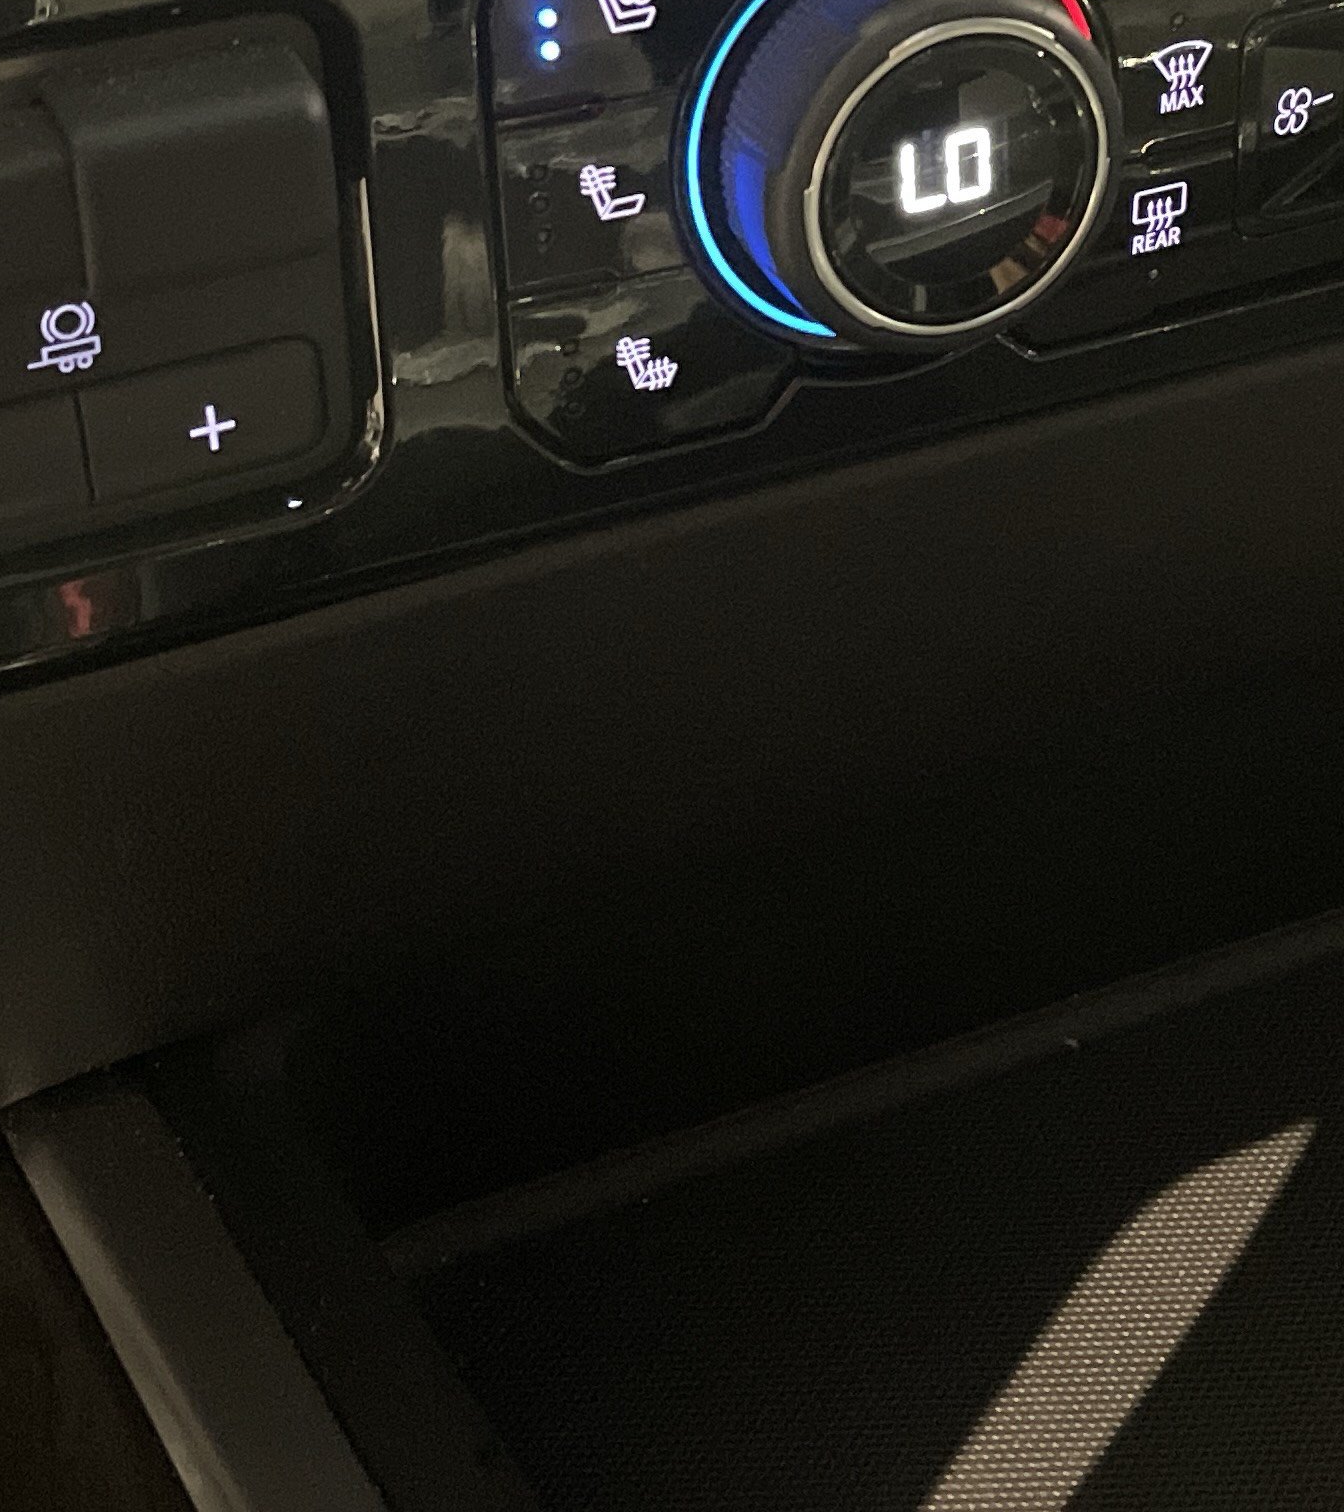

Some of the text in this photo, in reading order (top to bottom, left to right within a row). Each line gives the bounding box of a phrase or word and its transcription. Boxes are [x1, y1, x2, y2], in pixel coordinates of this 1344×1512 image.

[1159, 83, 1205, 115] MAX
[897, 125, 995, 217] LO
[1131, 223, 1182, 256] REAR
